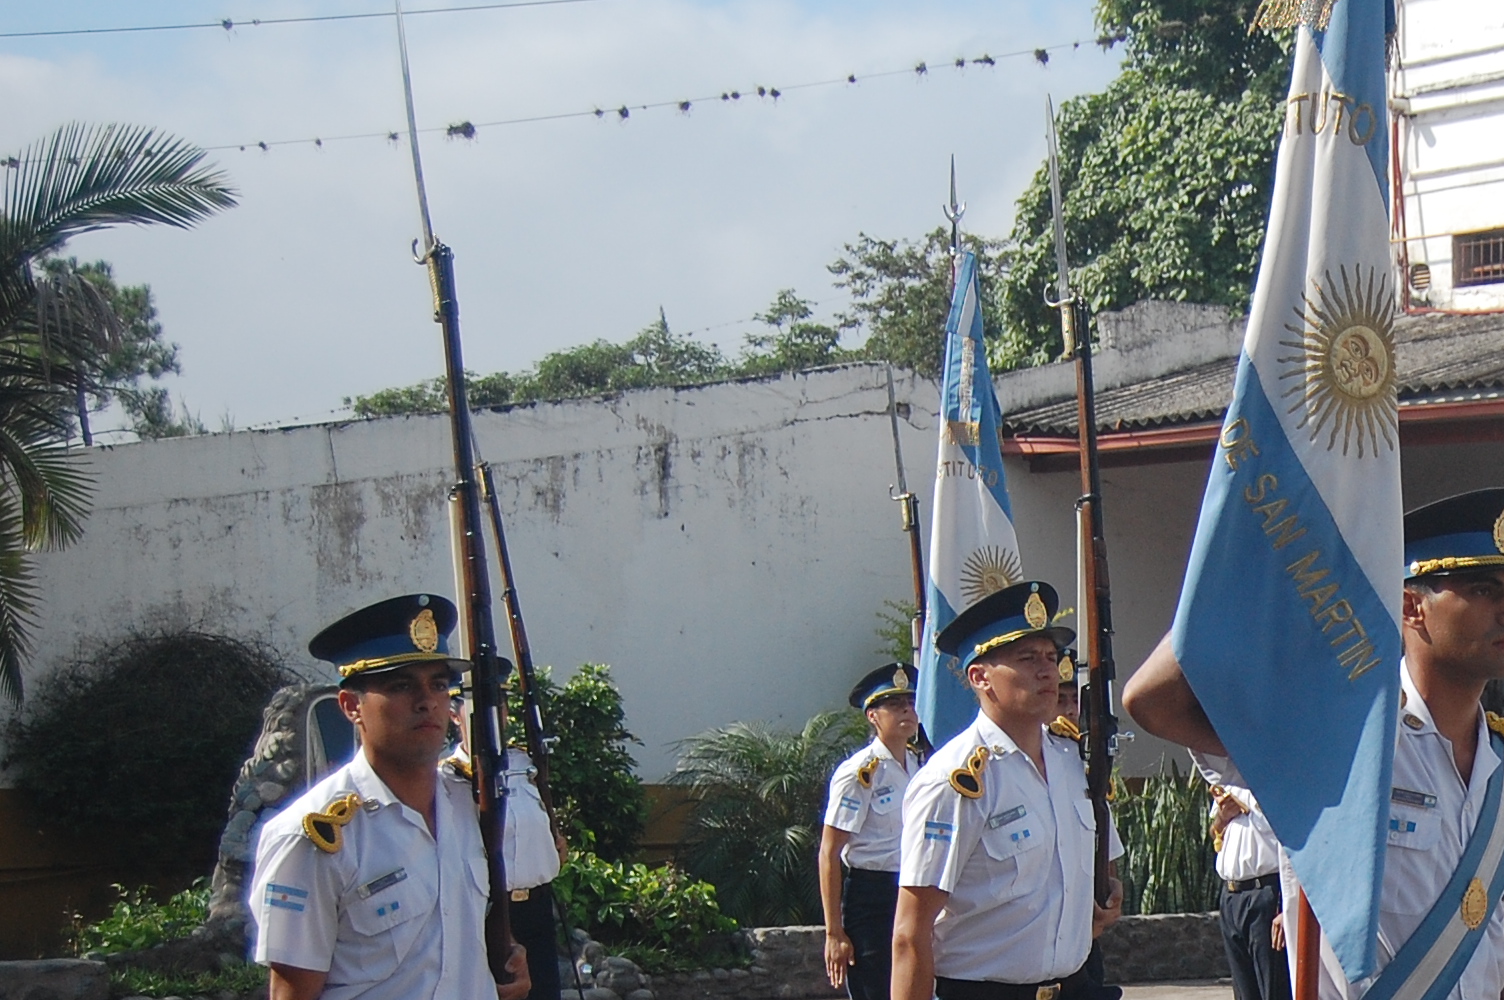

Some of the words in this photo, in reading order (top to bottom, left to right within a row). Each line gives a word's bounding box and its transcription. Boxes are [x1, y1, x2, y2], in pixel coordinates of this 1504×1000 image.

[1286, 91, 1377, 146] TUTO
[1220, 417, 1259, 471] DE
[1244, 474, 1307, 550] SAN
[1286, 550, 1382, 681] MARTIN
